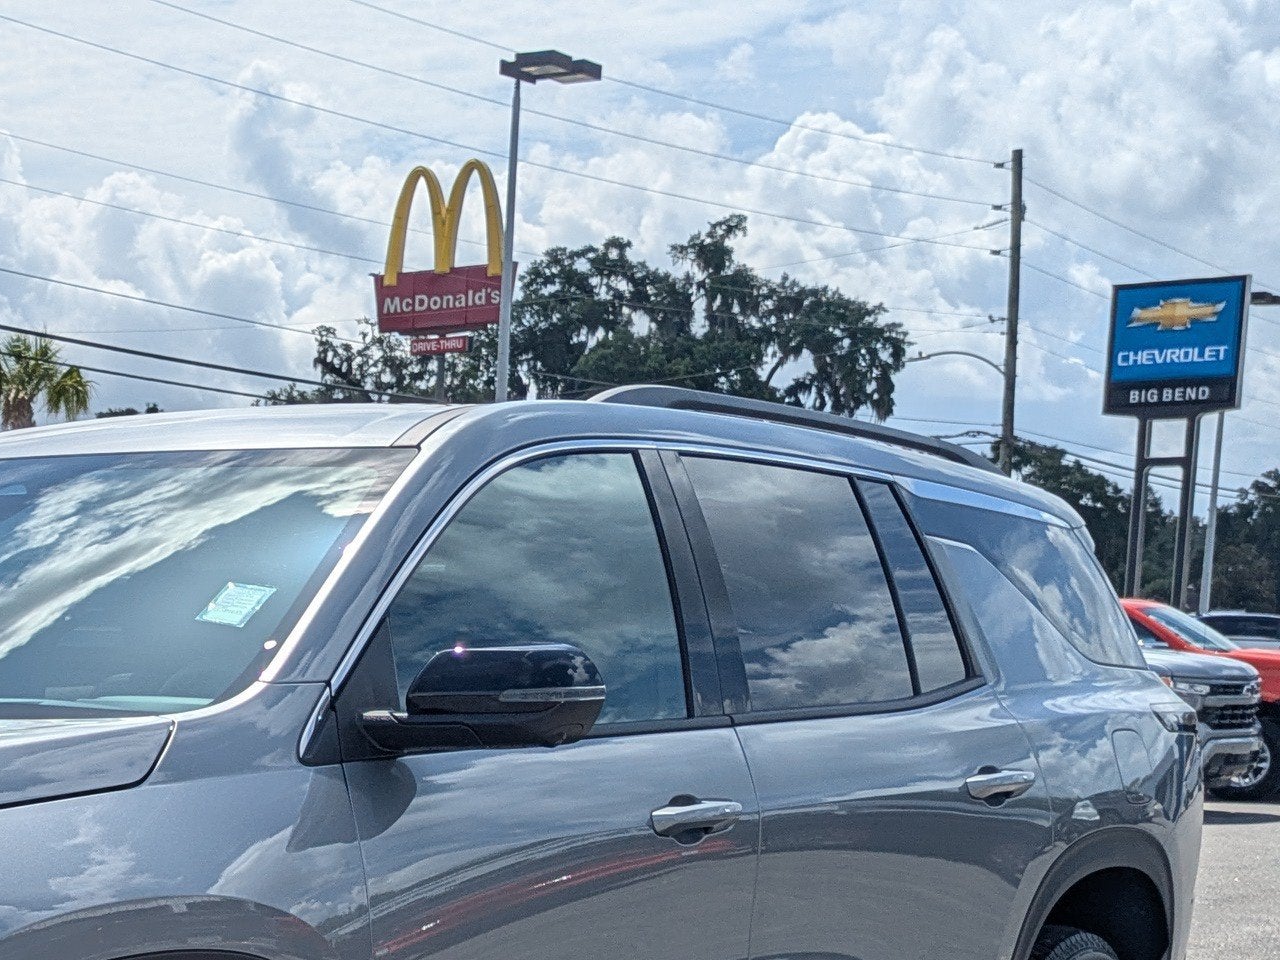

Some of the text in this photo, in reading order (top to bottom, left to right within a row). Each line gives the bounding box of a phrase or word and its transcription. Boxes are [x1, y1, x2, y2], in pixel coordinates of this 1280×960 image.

[382, 286, 501, 315] McDonald's
[1117, 345, 1228, 367] CHEVROLET
[1129, 386, 1210, 403] BIG BEND
